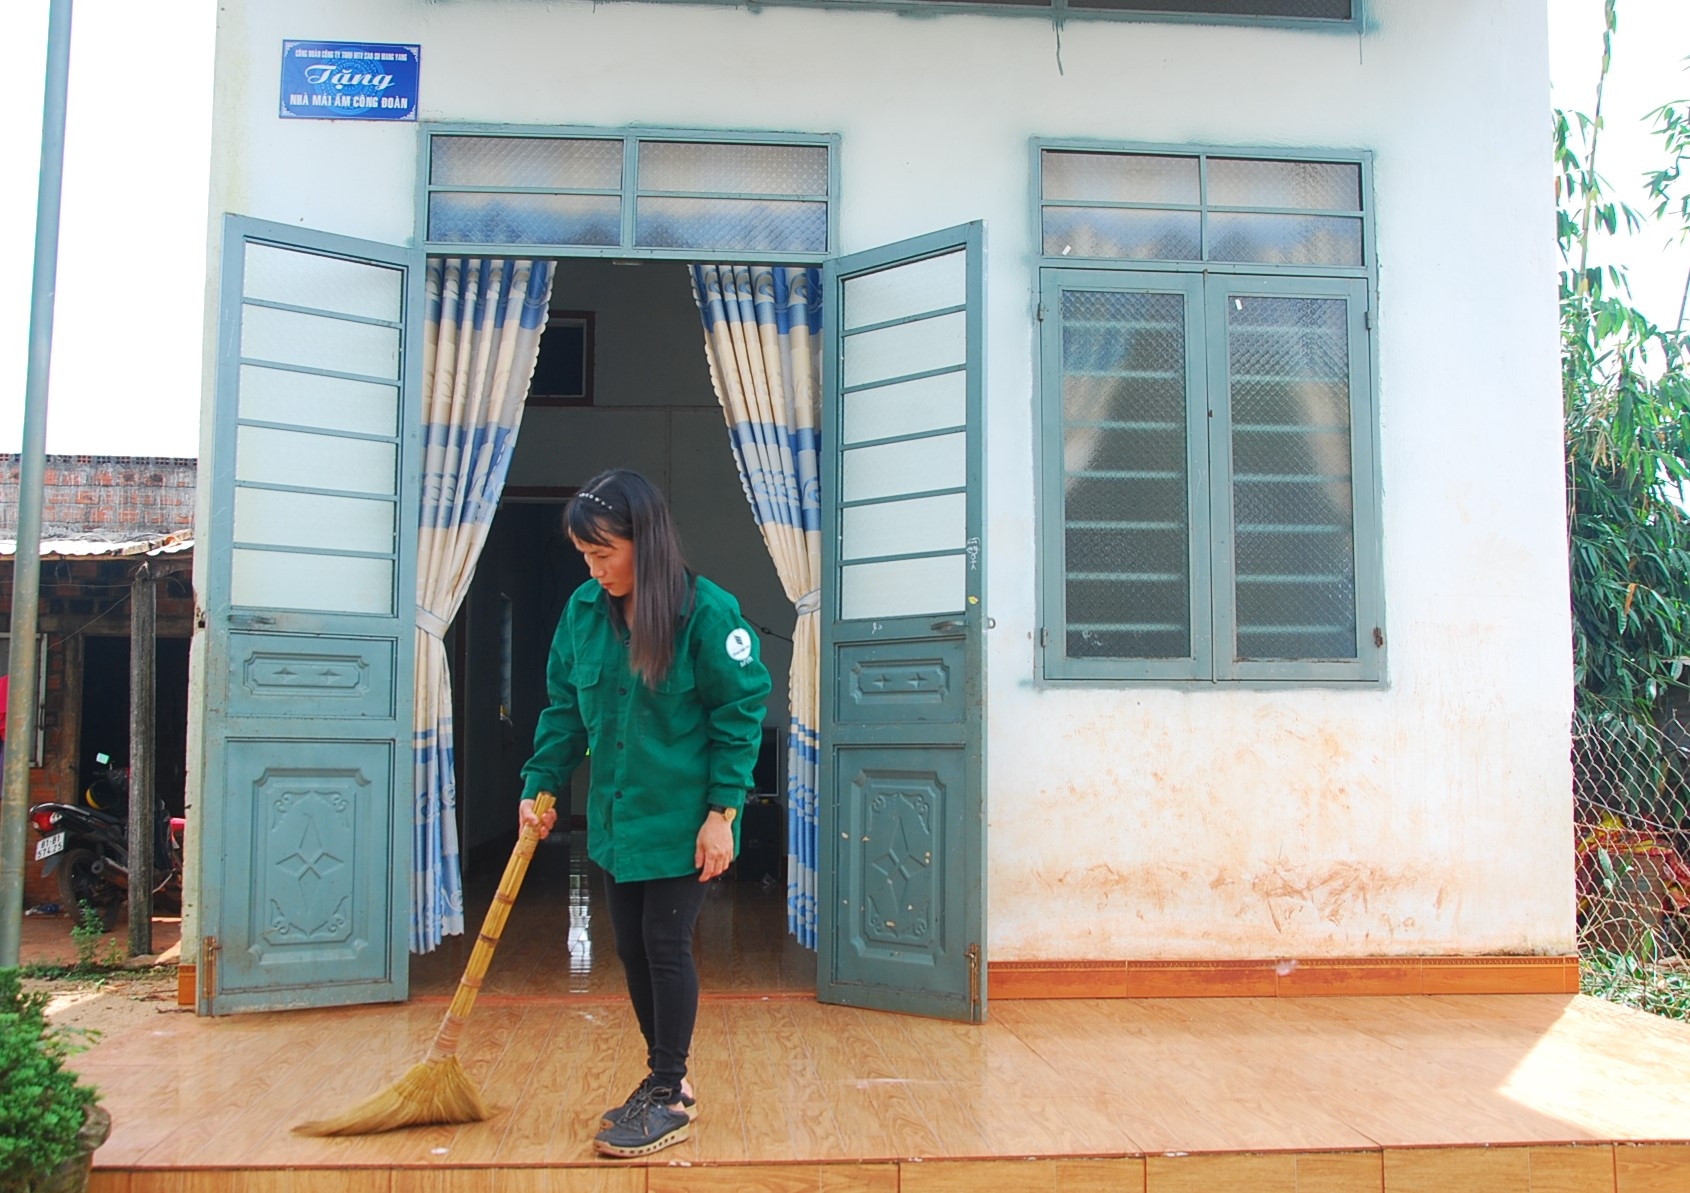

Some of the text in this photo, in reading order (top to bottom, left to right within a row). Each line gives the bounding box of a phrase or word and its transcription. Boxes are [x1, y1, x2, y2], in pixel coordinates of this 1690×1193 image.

[303, 63, 396, 91] Tặng
[289, 92, 408, 109] NHÀ MÁI ẤM CÔNG ĐOÀN
